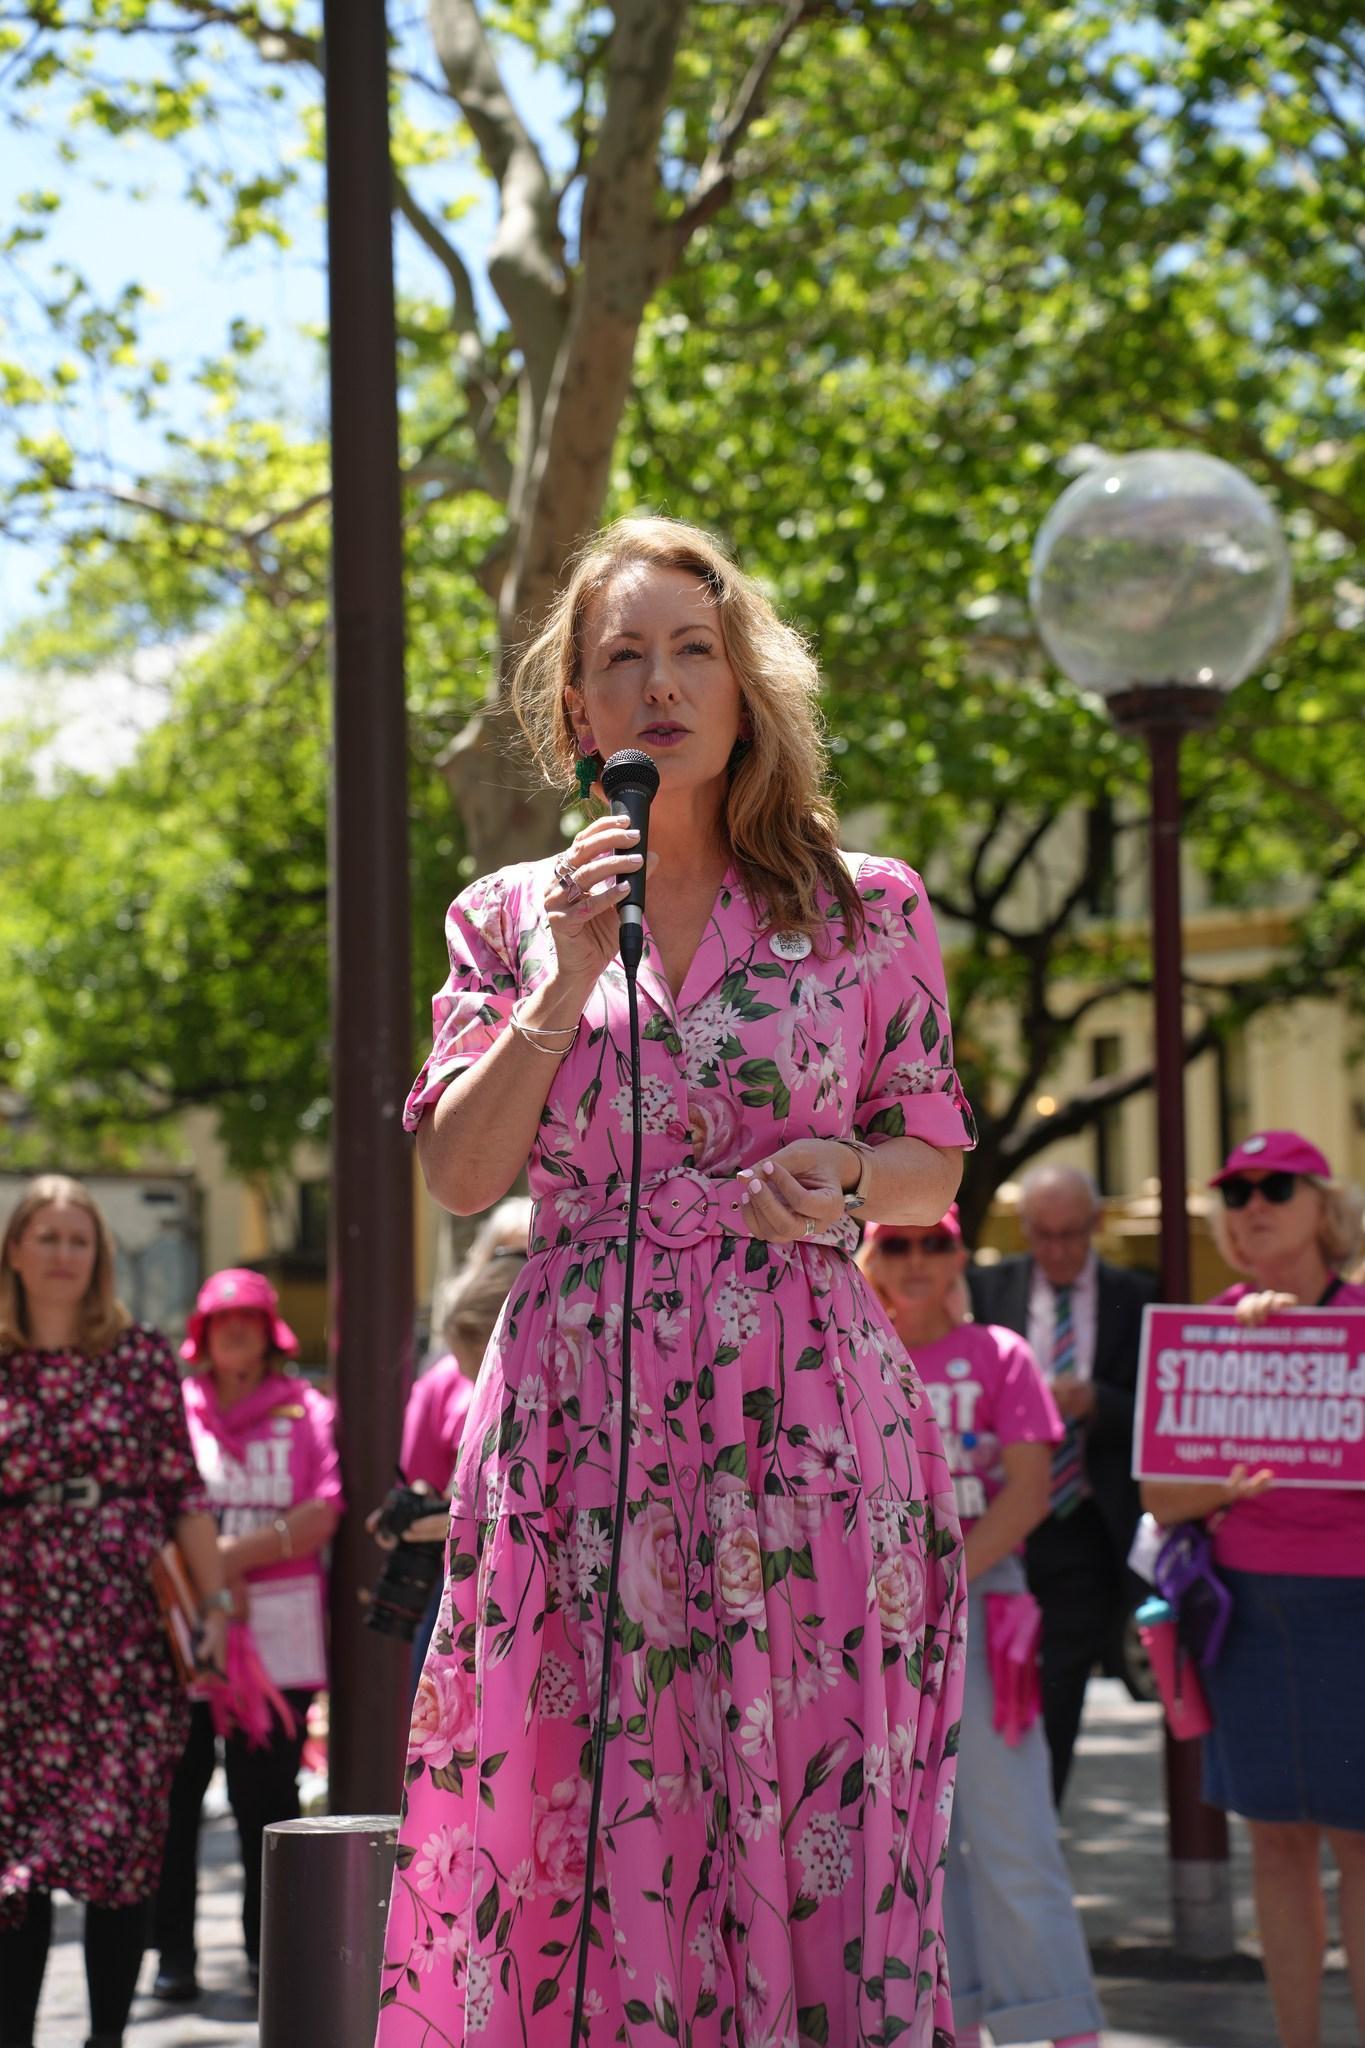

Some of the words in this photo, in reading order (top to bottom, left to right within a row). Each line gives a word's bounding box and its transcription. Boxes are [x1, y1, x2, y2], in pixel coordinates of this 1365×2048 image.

[780, 943, 797, 952] PAY
[1156, 1347, 1365, 1396] PRESCHOOLS
[925, 1381, 983, 1431] RT
[1155, 1393, 1365, 1443] COMMUNITY
[1174, 1442, 1217, 1462] with
[1219, 1440, 1306, 1466] standing
[1308, 1446, 1343, 1468] I'm
